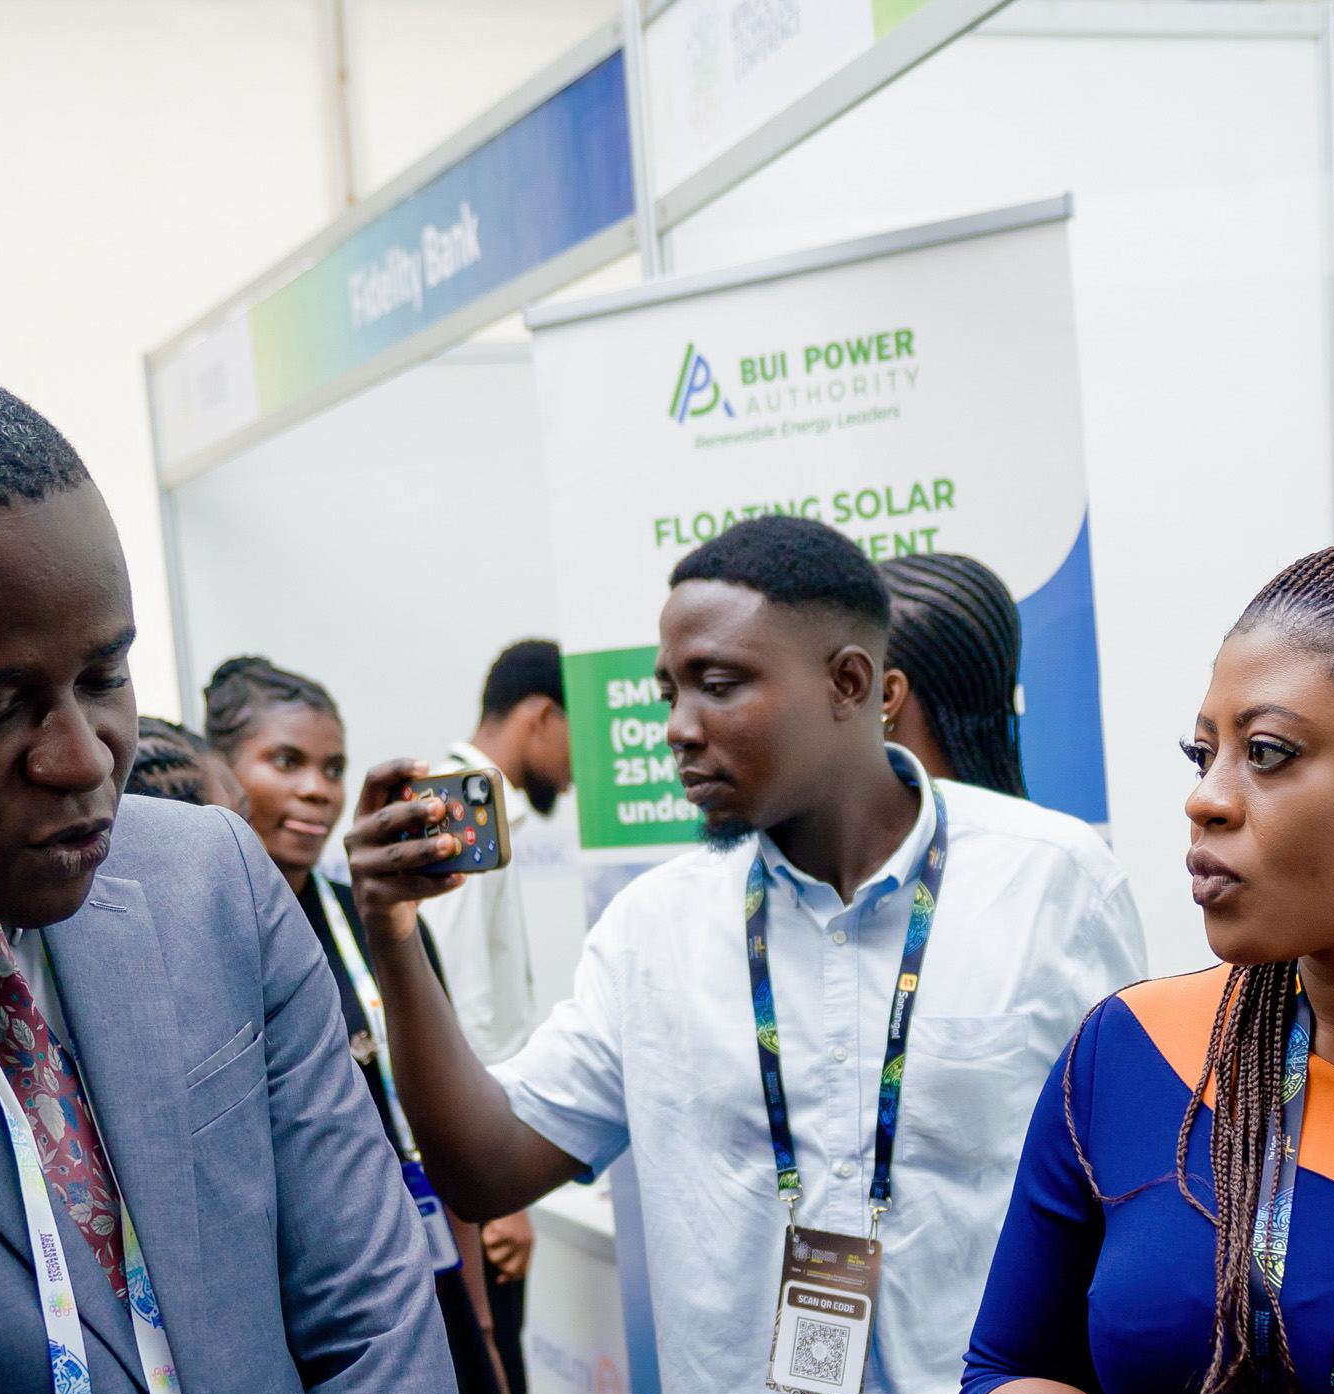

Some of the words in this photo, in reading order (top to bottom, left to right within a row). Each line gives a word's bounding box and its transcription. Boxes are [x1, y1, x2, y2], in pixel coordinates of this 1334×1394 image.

[349, 245, 424, 332] Fidelity
[422, 200, 482, 289] Bank
[740, 351, 788, 386] BUI
[804, 328, 915, 375] POWER
[746, 366, 920, 417] AUTHORITY
[781, 415, 833, 440] Energy
[837, 404, 901, 429] Leaders
[833, 477, 957, 524] SOLAR
[613, 757, 676, 787] 25M
[890, 989, 910, 1041] Sonangol
[798, 1294, 819, 1307] SCAN
[820, 1299, 832, 1310] QR
[833, 1302, 855, 1314] CODE
